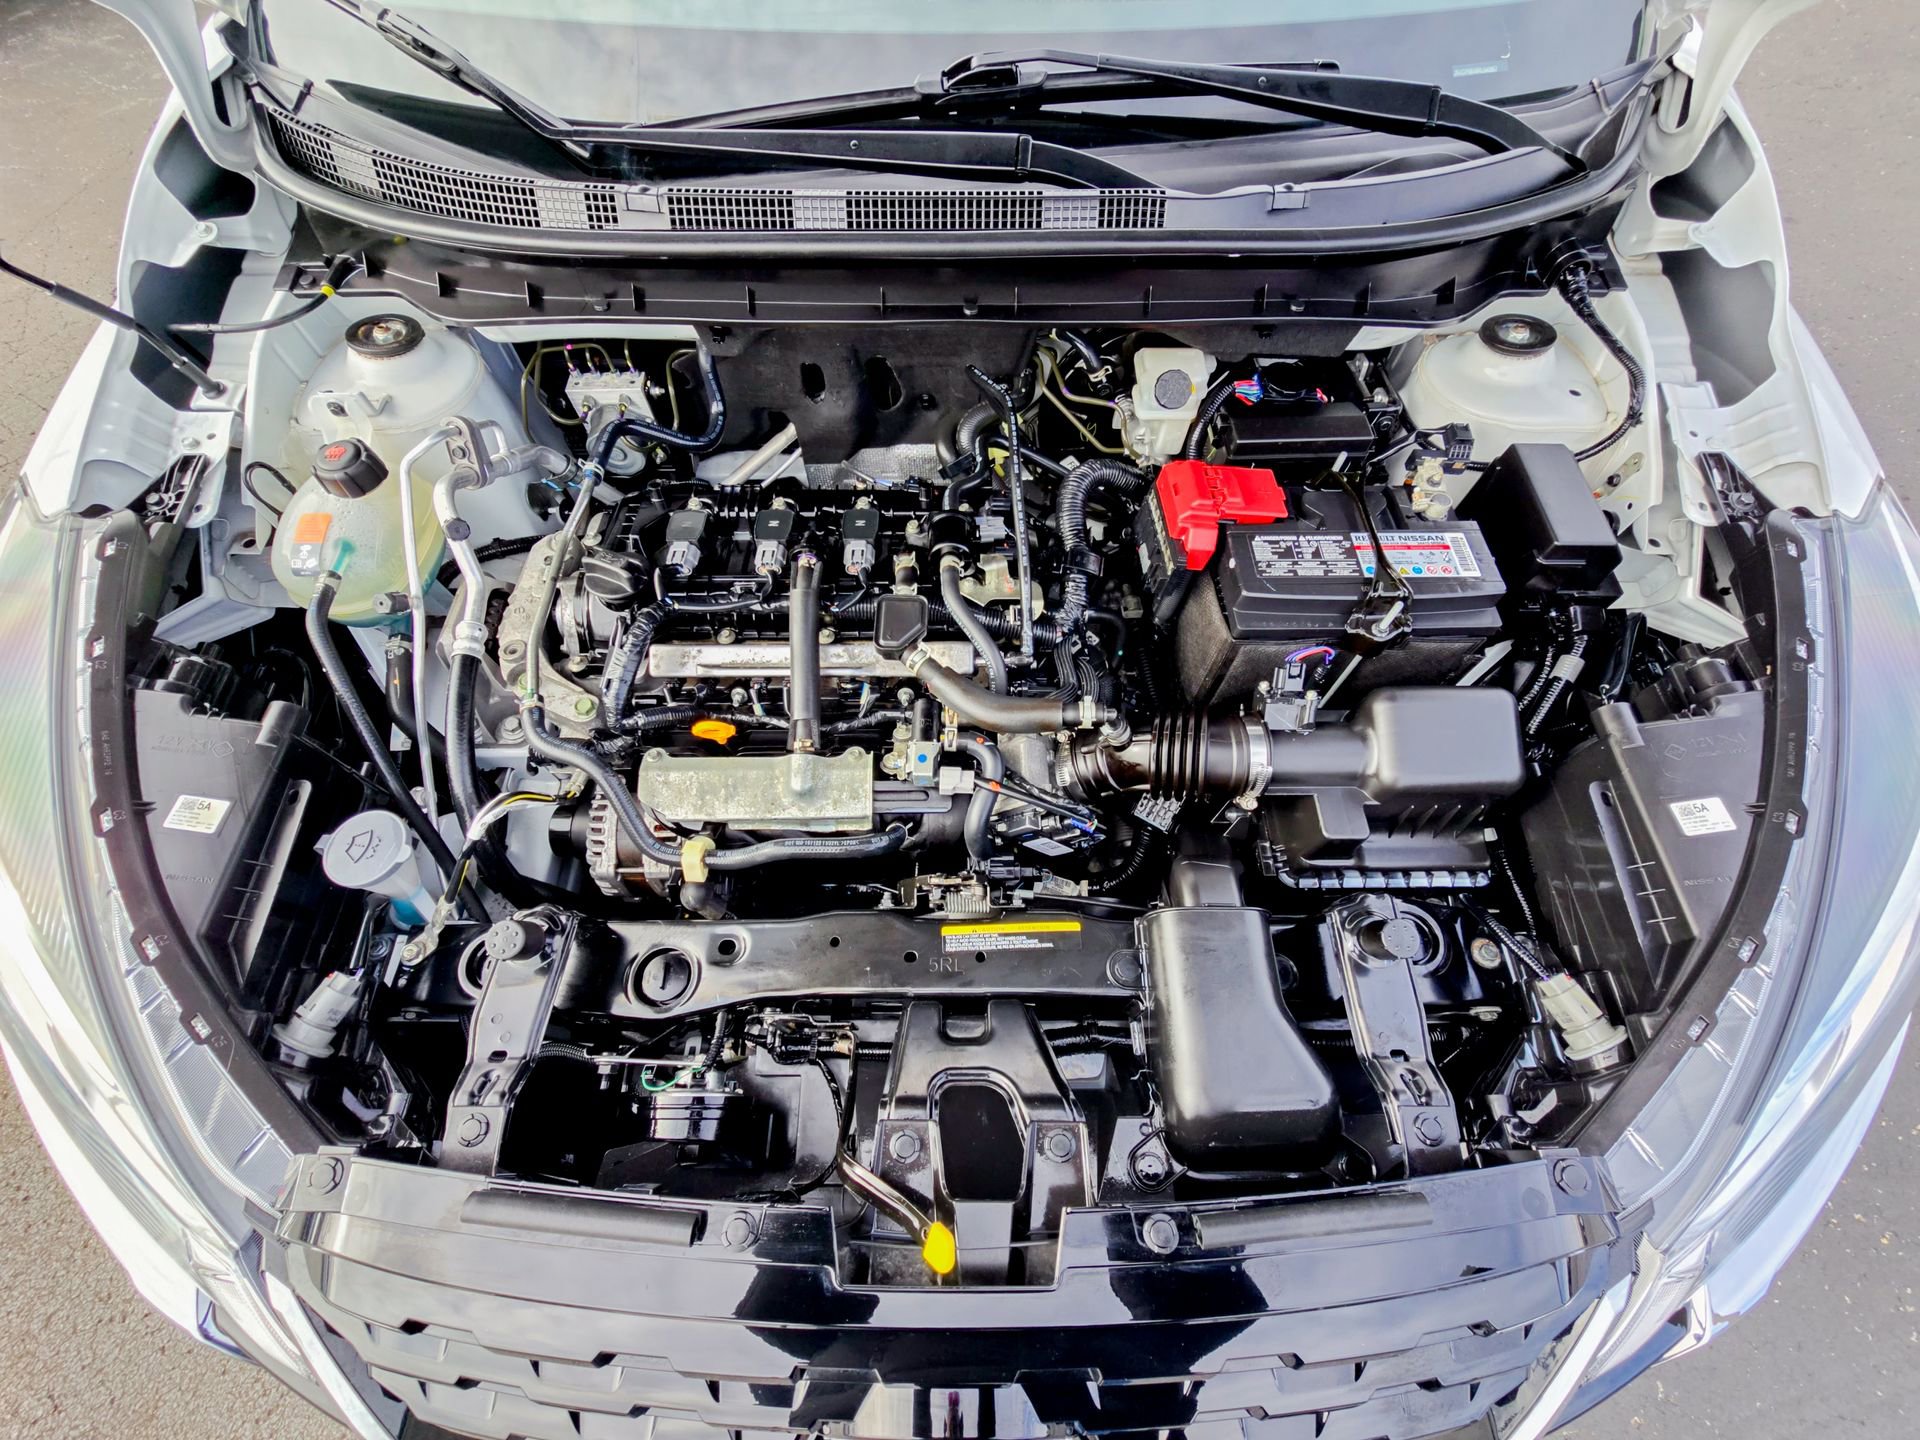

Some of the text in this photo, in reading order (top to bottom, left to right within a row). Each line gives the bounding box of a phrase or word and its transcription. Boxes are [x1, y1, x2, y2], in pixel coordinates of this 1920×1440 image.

[197, 800, 211, 811] 5A
[1692, 803, 1709, 813] 5A
[928, 956, 964, 973] 5RL
